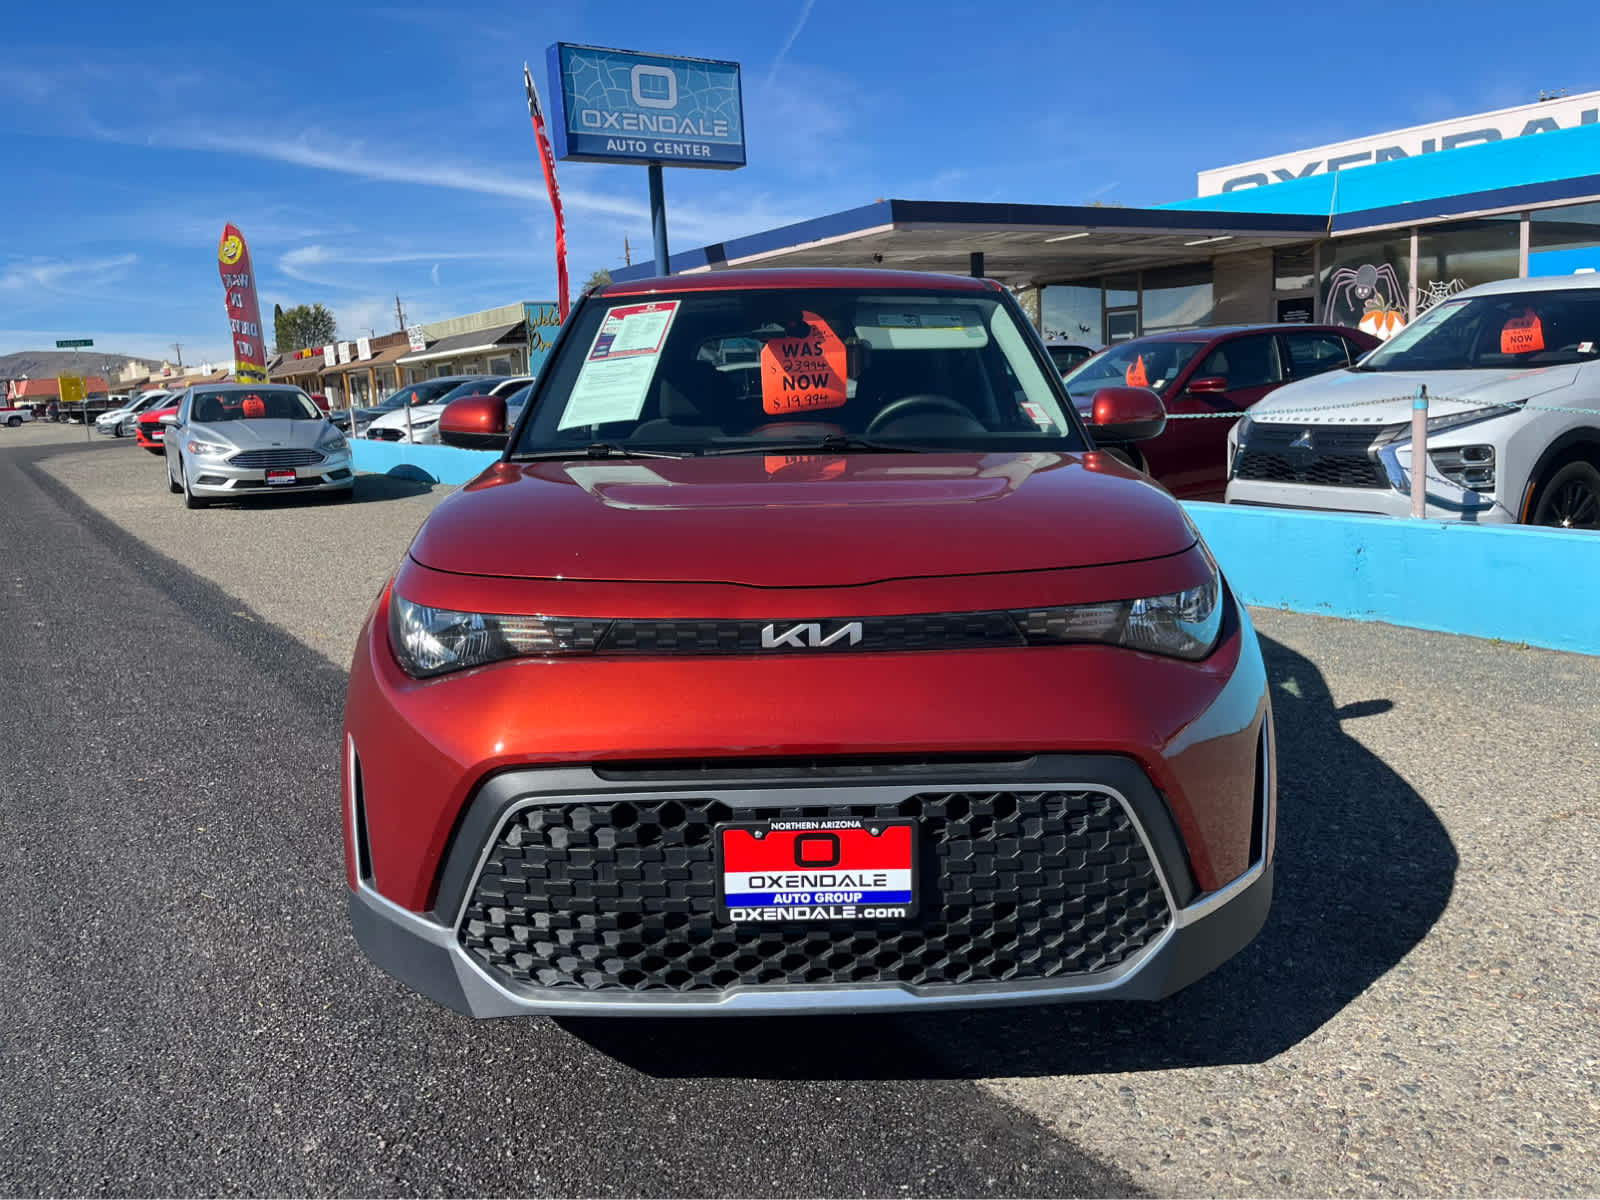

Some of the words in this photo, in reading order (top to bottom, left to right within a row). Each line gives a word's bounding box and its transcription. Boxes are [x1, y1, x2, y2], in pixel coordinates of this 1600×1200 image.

[582, 109, 728, 137] OXENDALE
[607, 139, 647, 153] AUTO
[653, 142, 711, 157] CENTER
[1510, 334, 1533, 344] NOW
[782, 342, 824, 358] WAS
[782, 373, 829, 391] NOW
[762, 622, 862, 648] KIA
[771, 821, 819, 831] NORTHERN
[821, 820, 862, 829] ARIZONA
[748, 873, 887, 889] OXENDALE
[773, 893, 811, 904] AUTO
[814, 892, 863, 904] GROUP
[729, 906, 906, 922] OXENDALE.com
